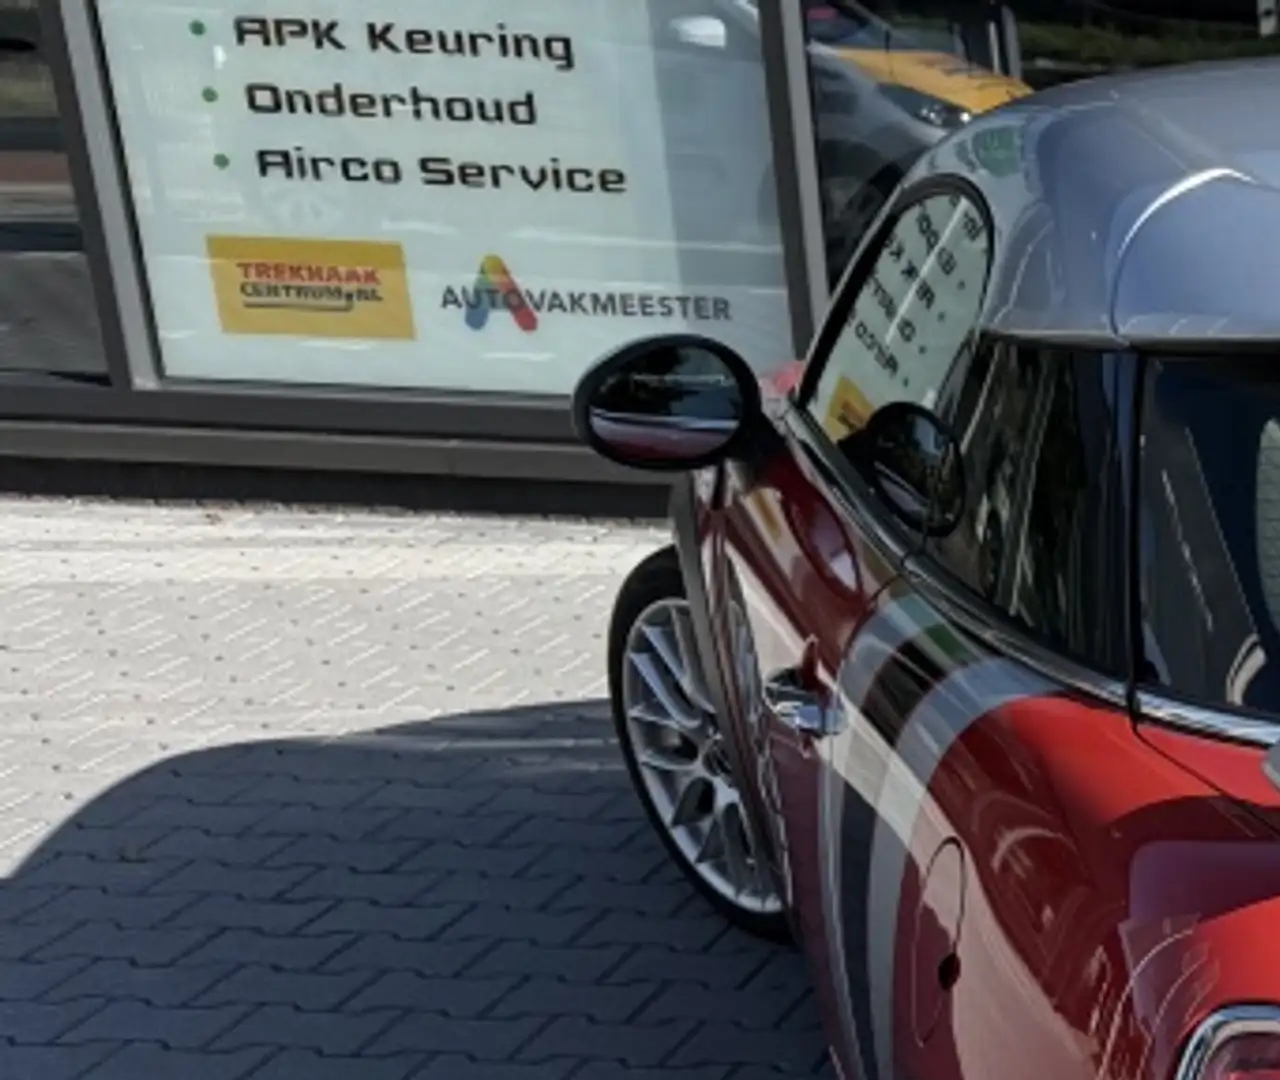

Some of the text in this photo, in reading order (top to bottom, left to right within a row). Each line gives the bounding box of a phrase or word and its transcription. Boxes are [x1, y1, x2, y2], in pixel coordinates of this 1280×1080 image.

[234, 16, 575, 70] APK Keuring
[245, 82, 537, 125] Onderhoud
[256, 146, 626, 193] Airco Service
[236, 262, 381, 286] TREKHAAK
[441, 284, 732, 320] AUTOVAKMEESTER
